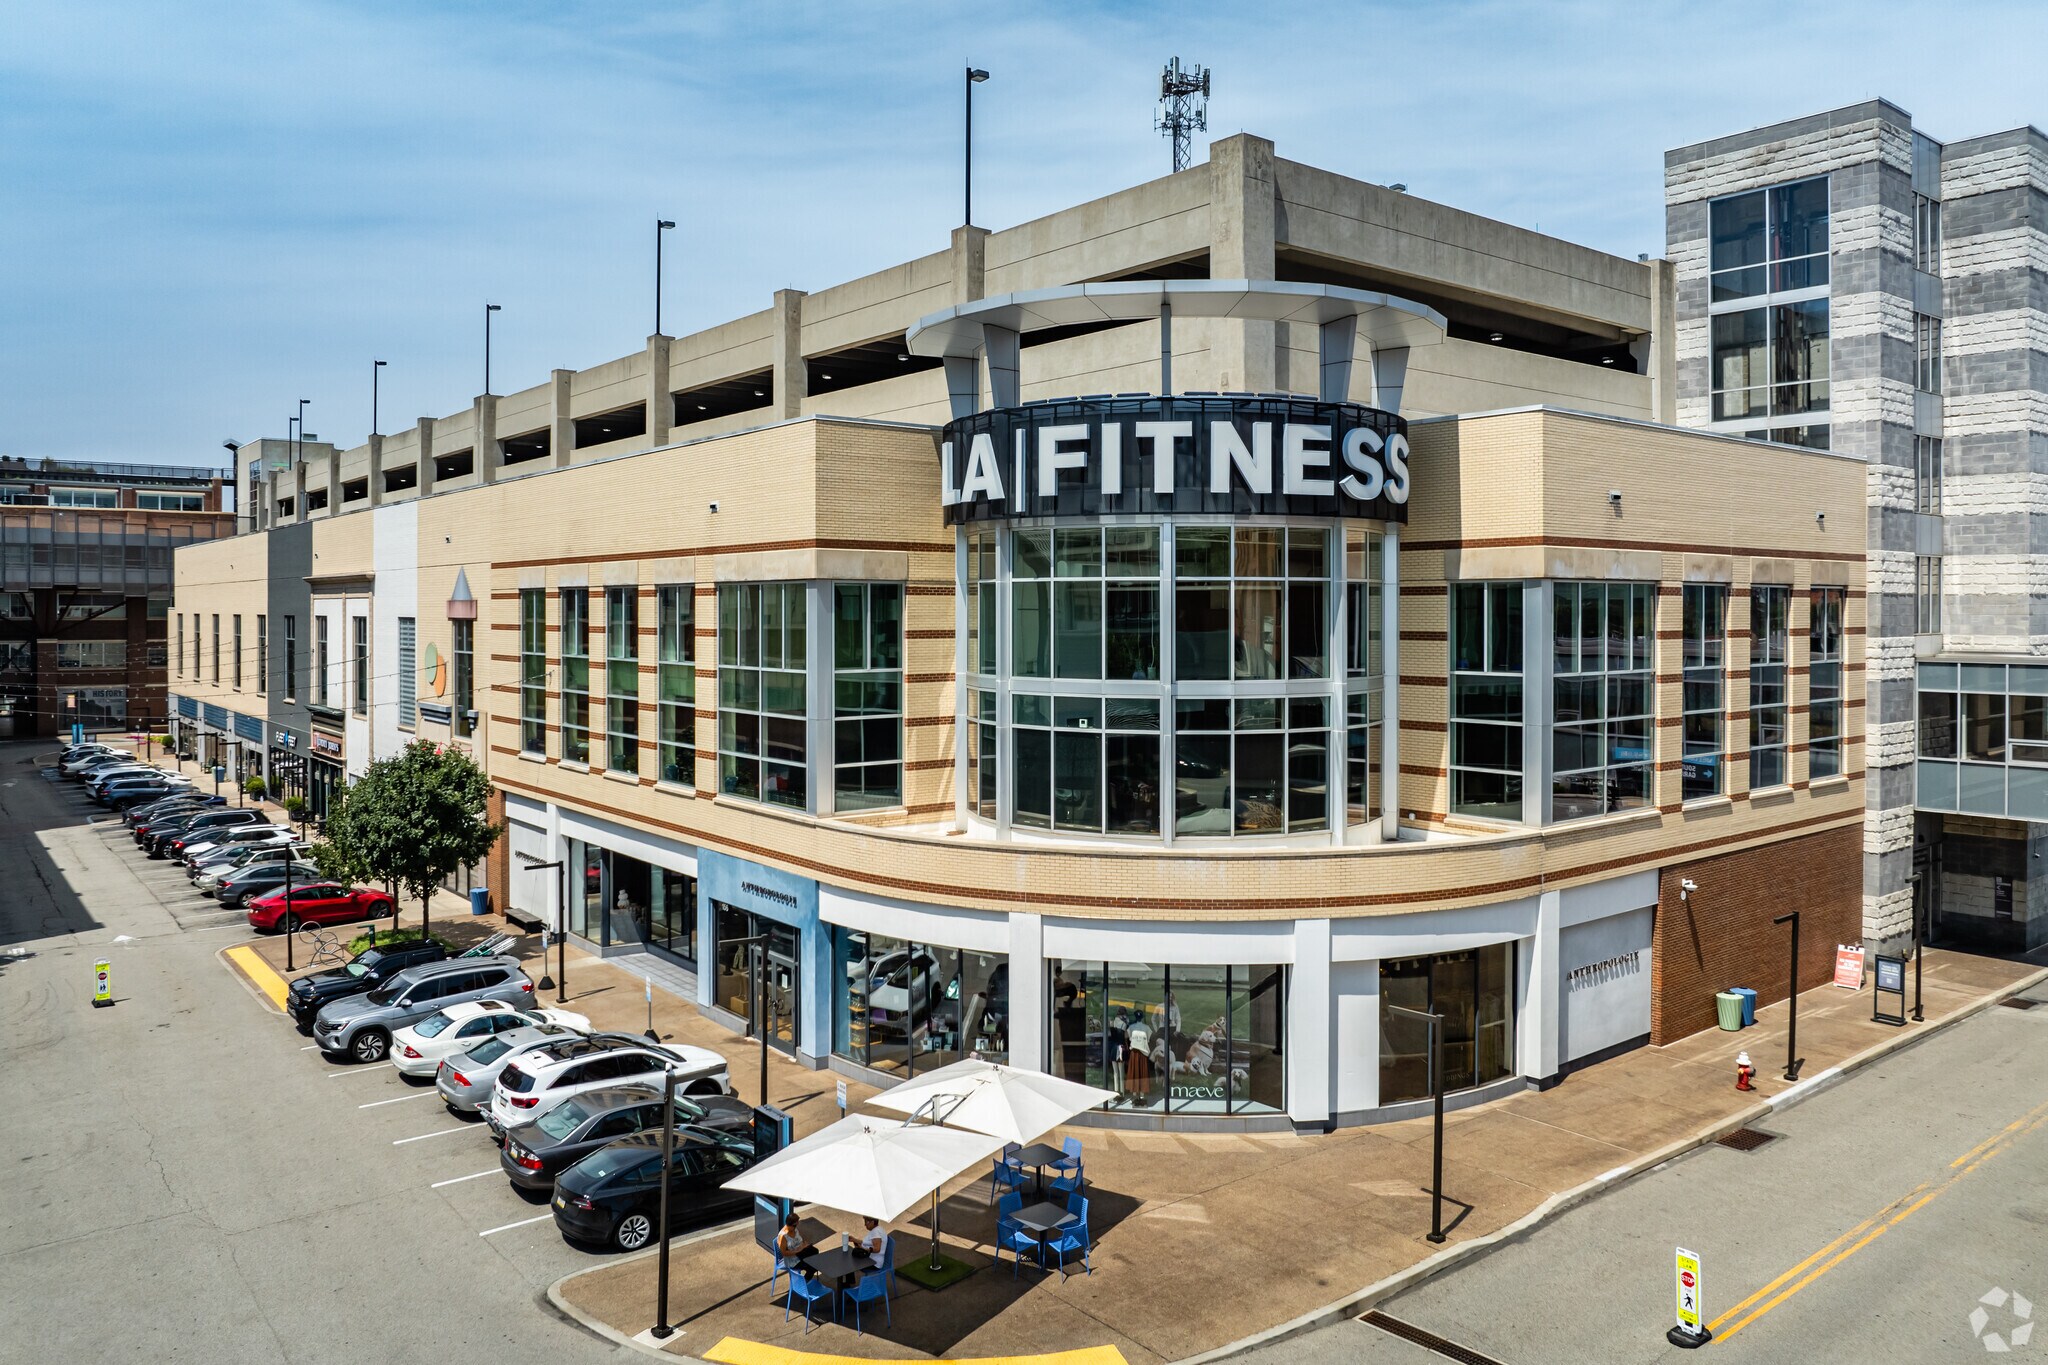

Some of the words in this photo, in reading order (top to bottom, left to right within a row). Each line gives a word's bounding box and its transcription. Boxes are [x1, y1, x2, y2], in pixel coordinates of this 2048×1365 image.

[942, 433, 1005, 507] LA
[1038, 421, 1410, 504] FITNESS
[1566, 950, 1639, 980] ANTHROPOLOGIE
[1681, 1275, 1695, 1284] STOP
